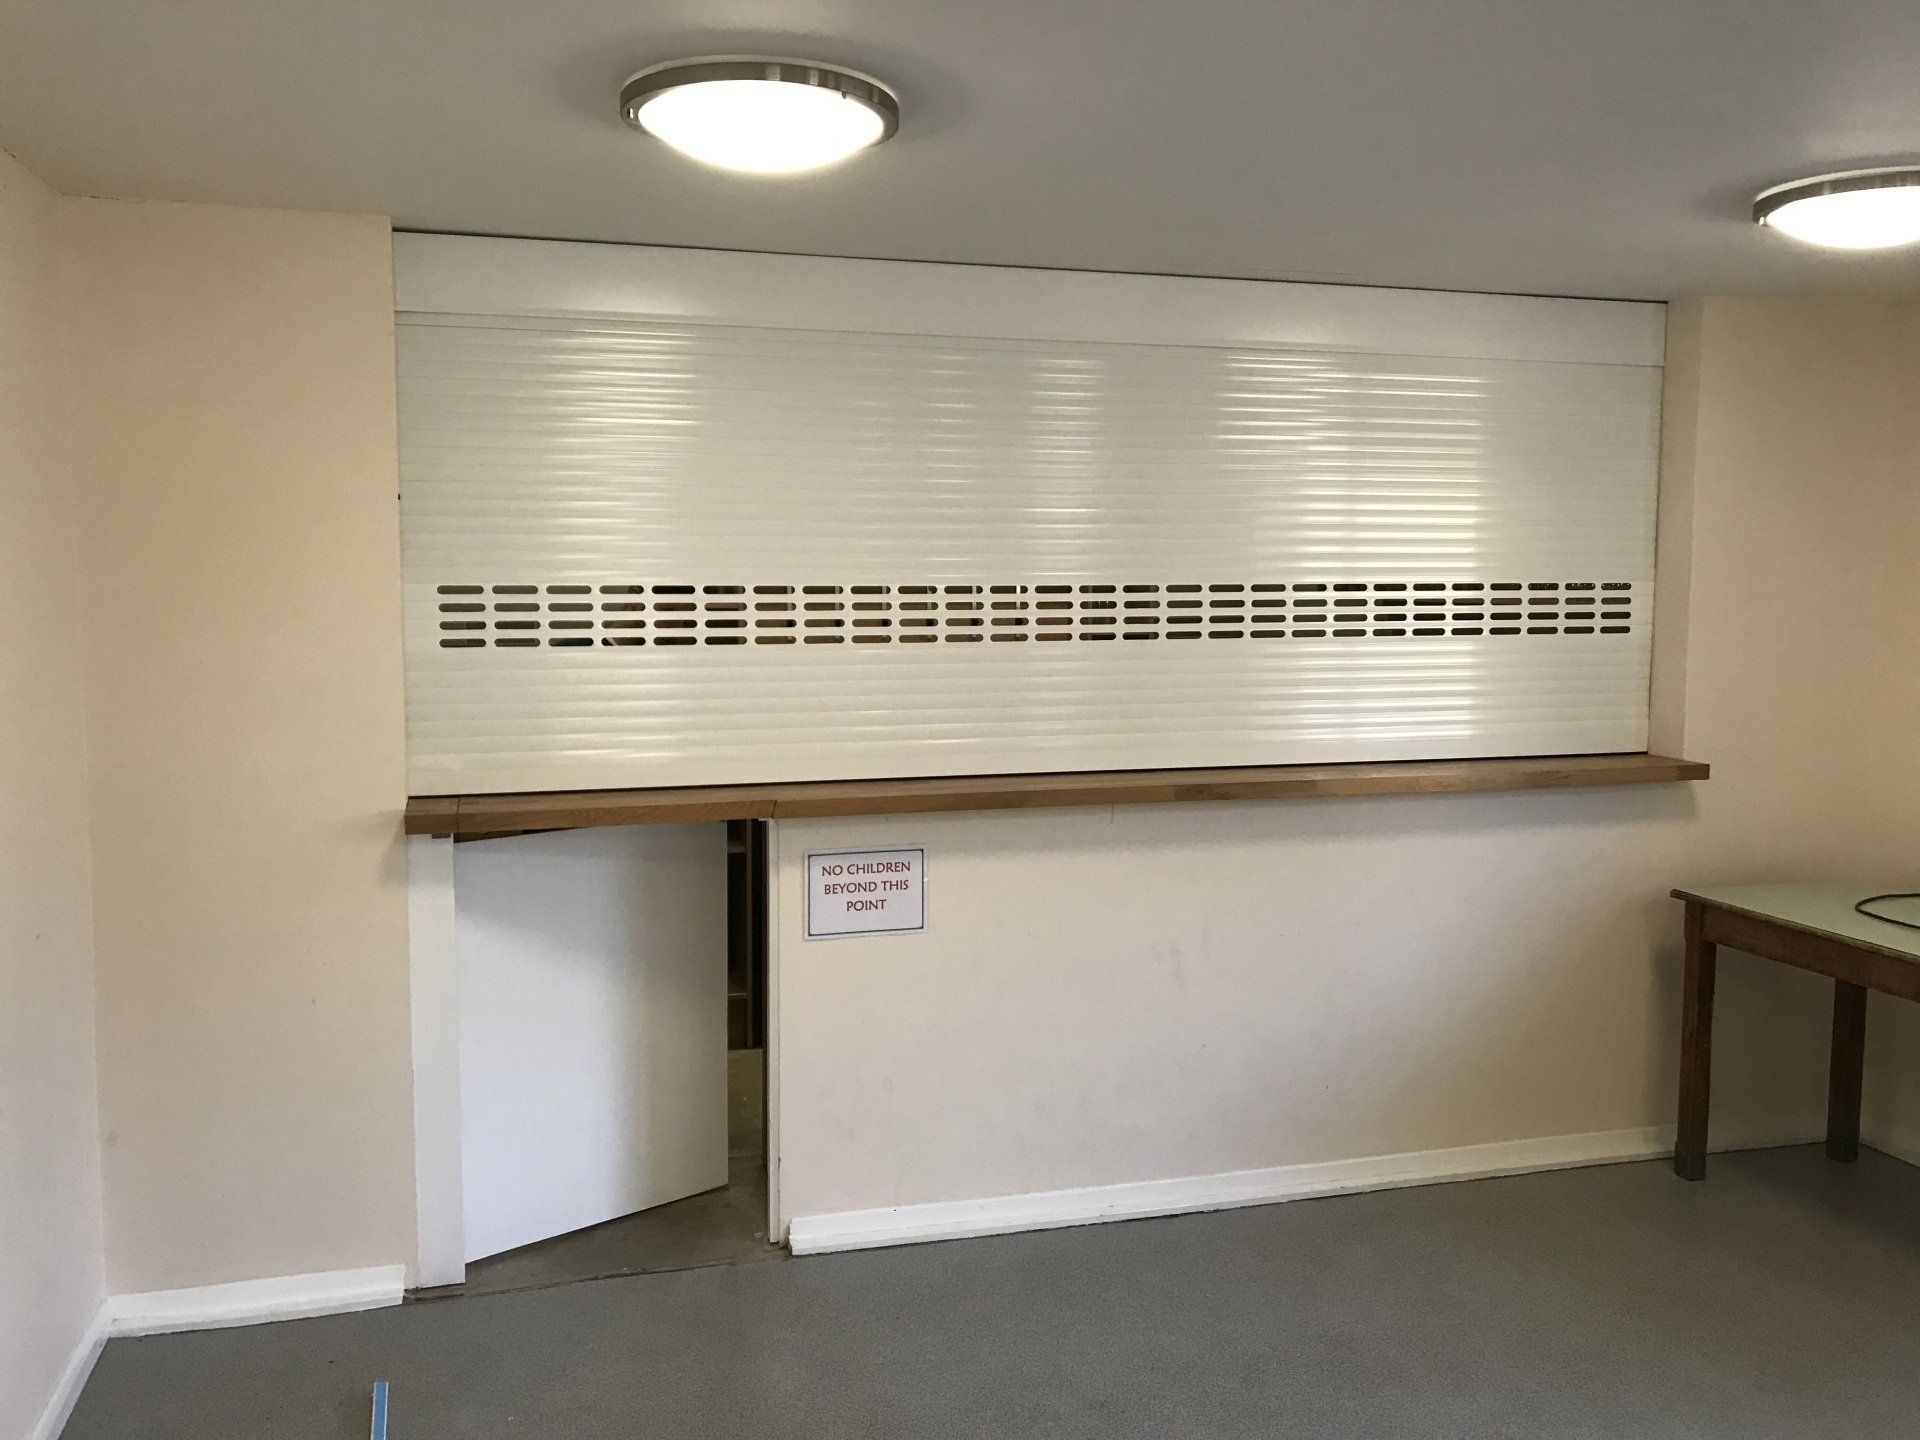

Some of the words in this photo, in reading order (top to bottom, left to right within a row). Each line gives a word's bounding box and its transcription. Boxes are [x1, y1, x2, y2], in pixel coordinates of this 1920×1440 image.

[821, 865, 843, 876] NO
[847, 861, 911, 875] CHILDREN
[824, 881, 877, 895] BEYOND
[881, 880, 909, 891] THIS
[846, 899, 887, 912] POINT
